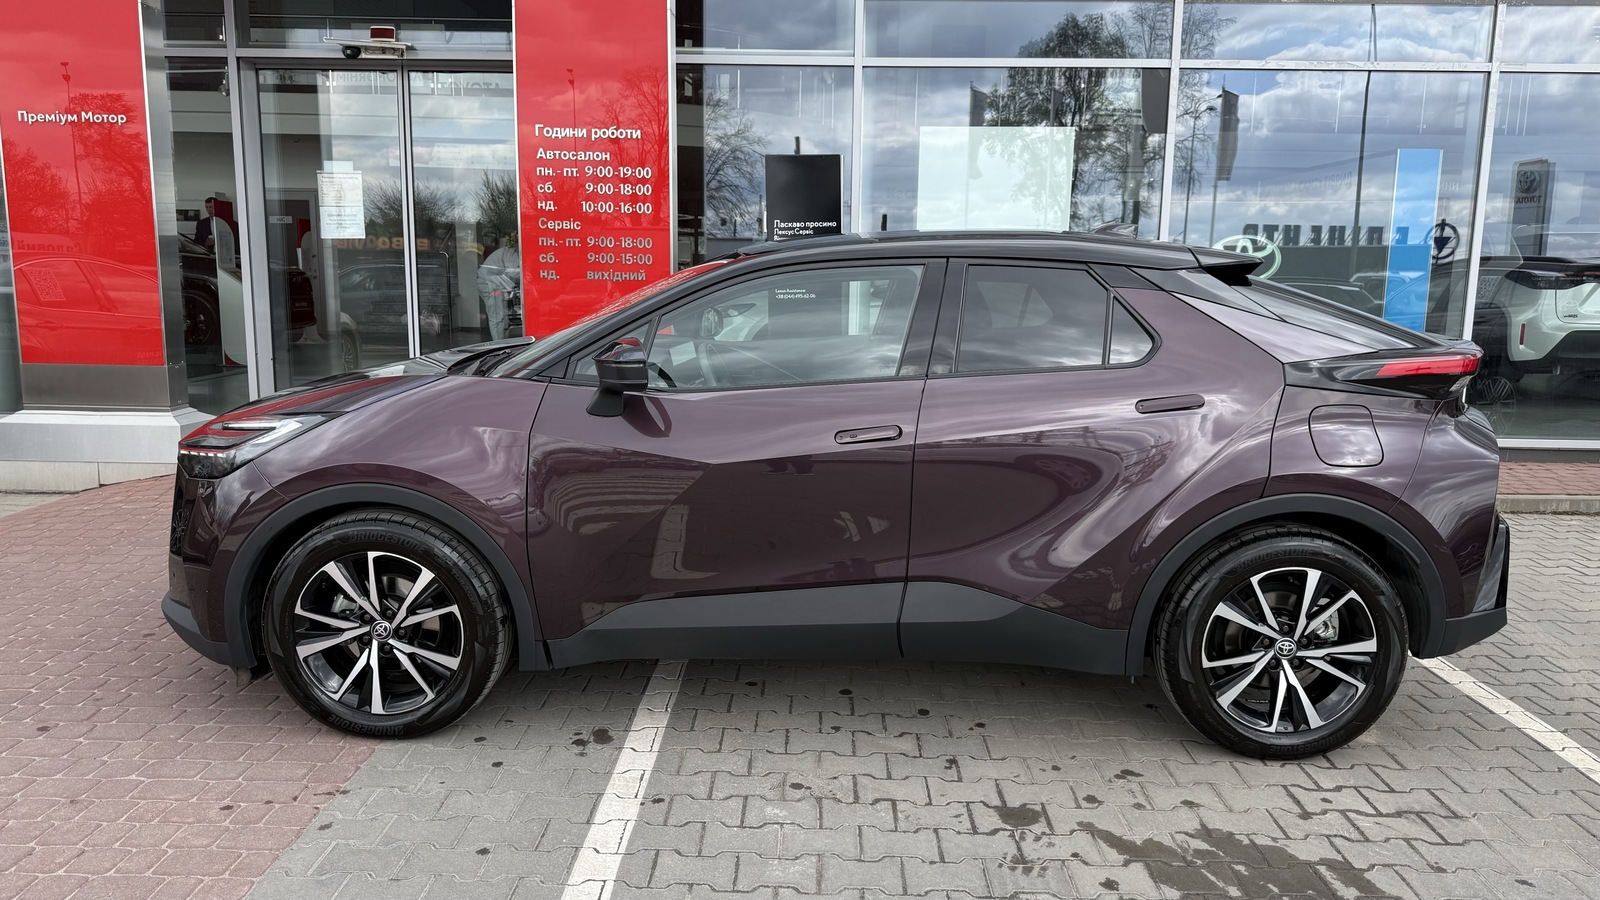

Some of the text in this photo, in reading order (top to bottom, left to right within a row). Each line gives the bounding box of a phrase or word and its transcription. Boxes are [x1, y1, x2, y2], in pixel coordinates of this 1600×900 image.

[17, 110, 127, 126] Преміум Мотор
[535, 124, 641, 141] Години роботи
[536, 147, 610, 161] Автосалон
[585, 165, 652, 178] 9:00-19:00
[537, 181, 652, 195] сб. 9:00-18:00
[537, 200, 652, 214] нд. 10:00-16:00
[538, 217, 582, 231] Сервіс
[774, 219, 837, 229] Ласкаво просимо
[586, 236, 653, 249] 9:00-18:00
[539, 252, 653, 265] сб. 9:00-15:00
[539, 269, 647, 281] нд. вихідний
[347, 530, 428, 554] BRIDGESTONE
[326, 714, 405, 736] BRIDGESTONE
